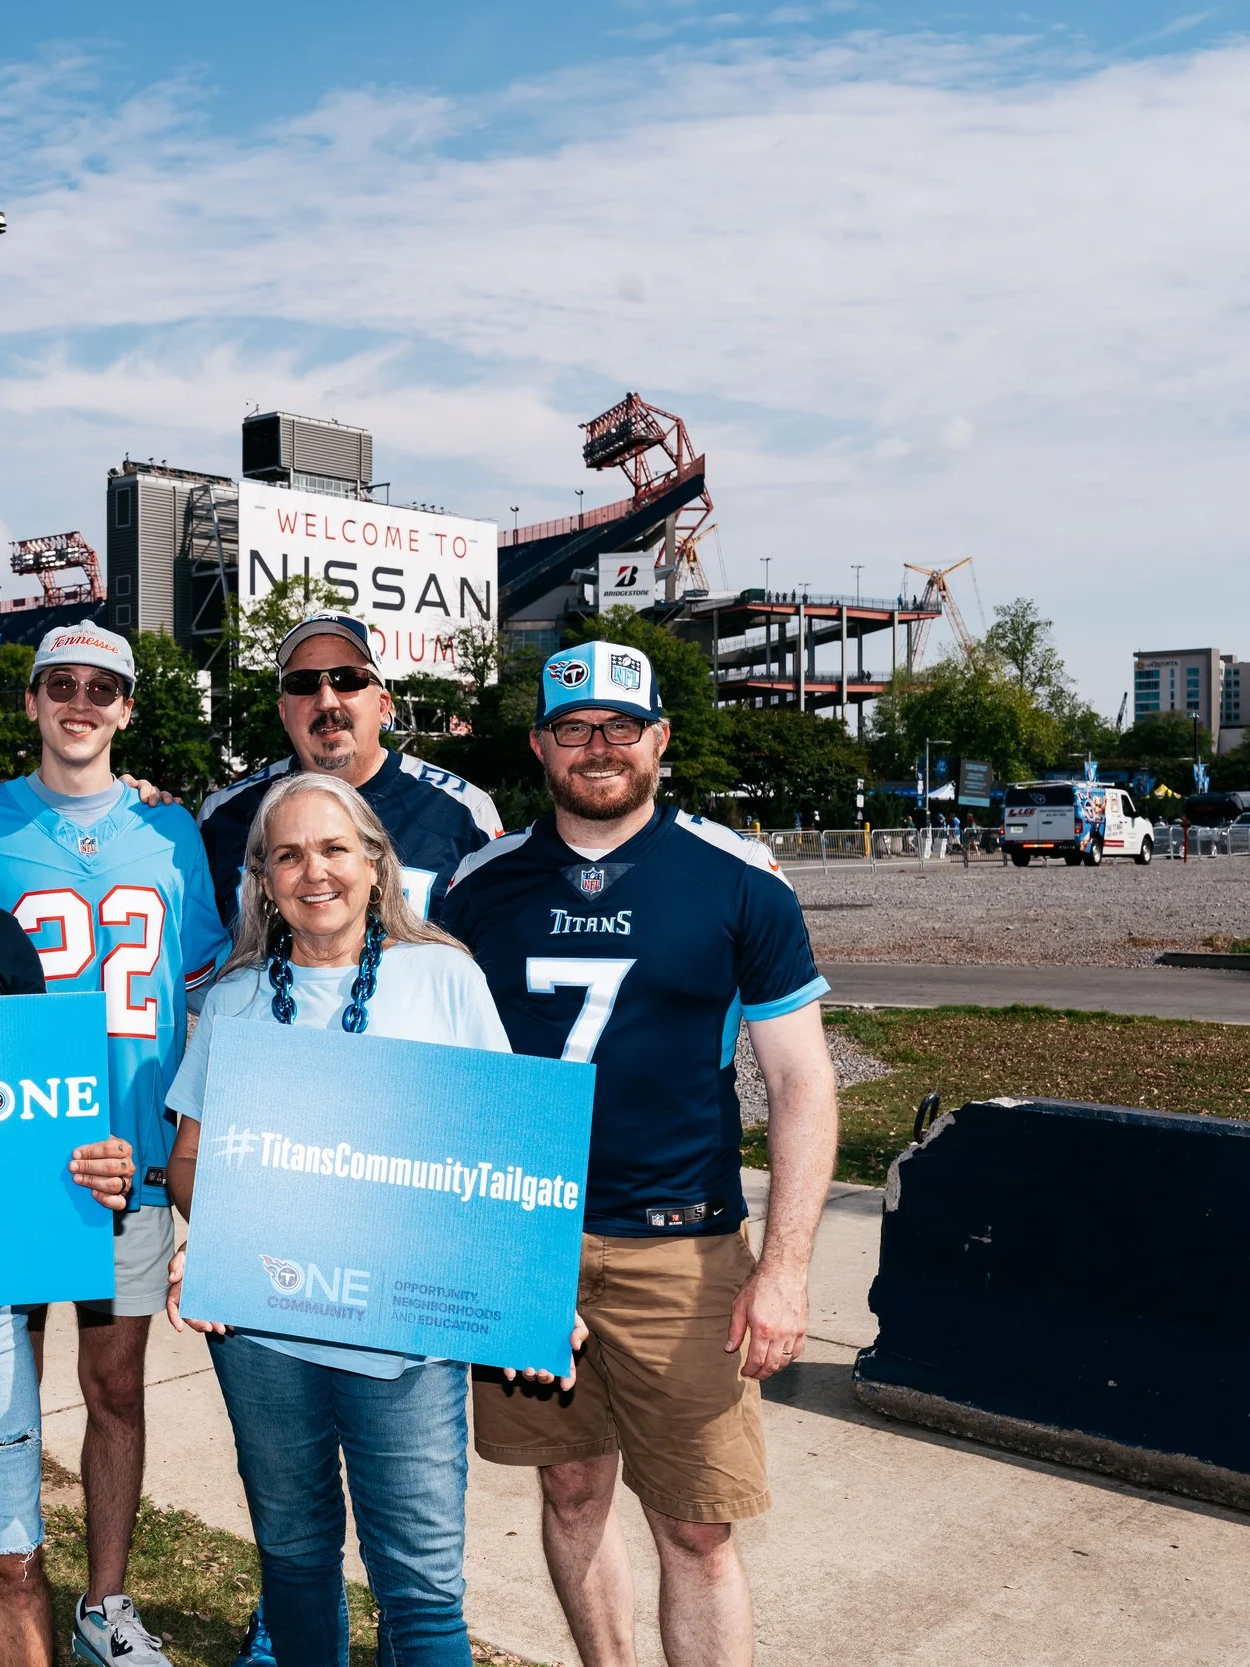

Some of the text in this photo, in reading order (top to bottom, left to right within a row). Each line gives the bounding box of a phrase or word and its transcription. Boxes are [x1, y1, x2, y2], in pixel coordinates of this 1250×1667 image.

[277, 508, 467, 558] WELCOME TO
[250, 549, 491, 621] NISSAN
[604, 589, 649, 597] BRIDGESTONE
[50, 635, 120, 653] Tennessee
[371, 629, 455, 664] DIUM
[612, 666, 639, 688] NFL
[81, 845, 96, 853] NFL
[583, 878, 601, 891] NFL
[550, 909, 632, 936] TITANS
[526, 957, 638, 1064] 7
[210, 1124, 579, 1211] #TitansCommunityTailgate
[268, 1259, 371, 1307] ONE
[266, 1295, 366, 1322] COMMUNITY
[393, 1295, 502, 1321] NEIGHBORHOODS
[391, 1311, 489, 1335] AND EDUCATION
